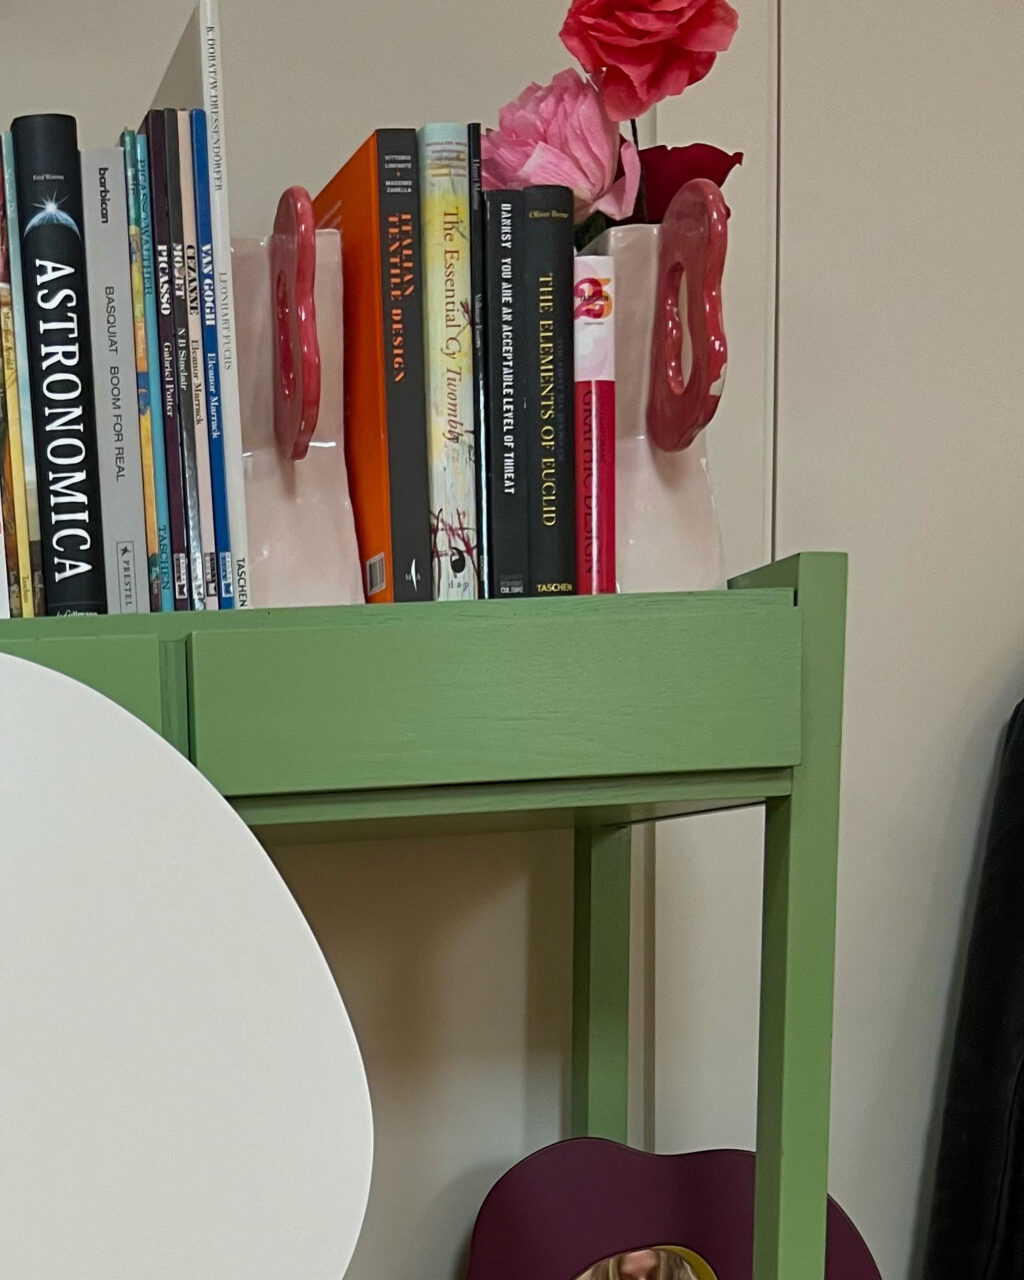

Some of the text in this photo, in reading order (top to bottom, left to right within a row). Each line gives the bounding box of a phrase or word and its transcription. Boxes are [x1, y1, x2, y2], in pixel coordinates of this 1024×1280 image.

[98, 168, 110, 223] barbican
[401, 213, 415, 297] ITALIAN
[157, 244, 175, 418] PICASSO Gabriel Potter
[172, 242, 185, 299] MOET
[186, 244, 204, 426] CEZANNE Eleanor Marrack
[218, 273, 232, 371] LEONHART FUCHS
[388, 213, 404, 382] TEXTILE DESIGN
[440, 207, 464, 443] The Essential Cy Twombly
[105, 286, 126, 483] BASQUIAT BOOM FOR REAL
[178, 350, 189, 391] Sinclair
[201, 243, 221, 439] VAN GOGH Eleanor Marrack
[501, 203, 515, 494] BANKSY YOU ARE AN ACCEPTABLE LEVEL OF THREAT
[539, 272, 557, 526] THE ELEMENTS OF EUCLID
[35, 258, 92, 582] ASTRONOMICA
[123, 560, 133, 607] PRESTEL
[158, 525, 170, 591] TASCHEN
[236, 557, 248, 607] TASCHEN
[536, 583, 572, 592] TASCHEN
